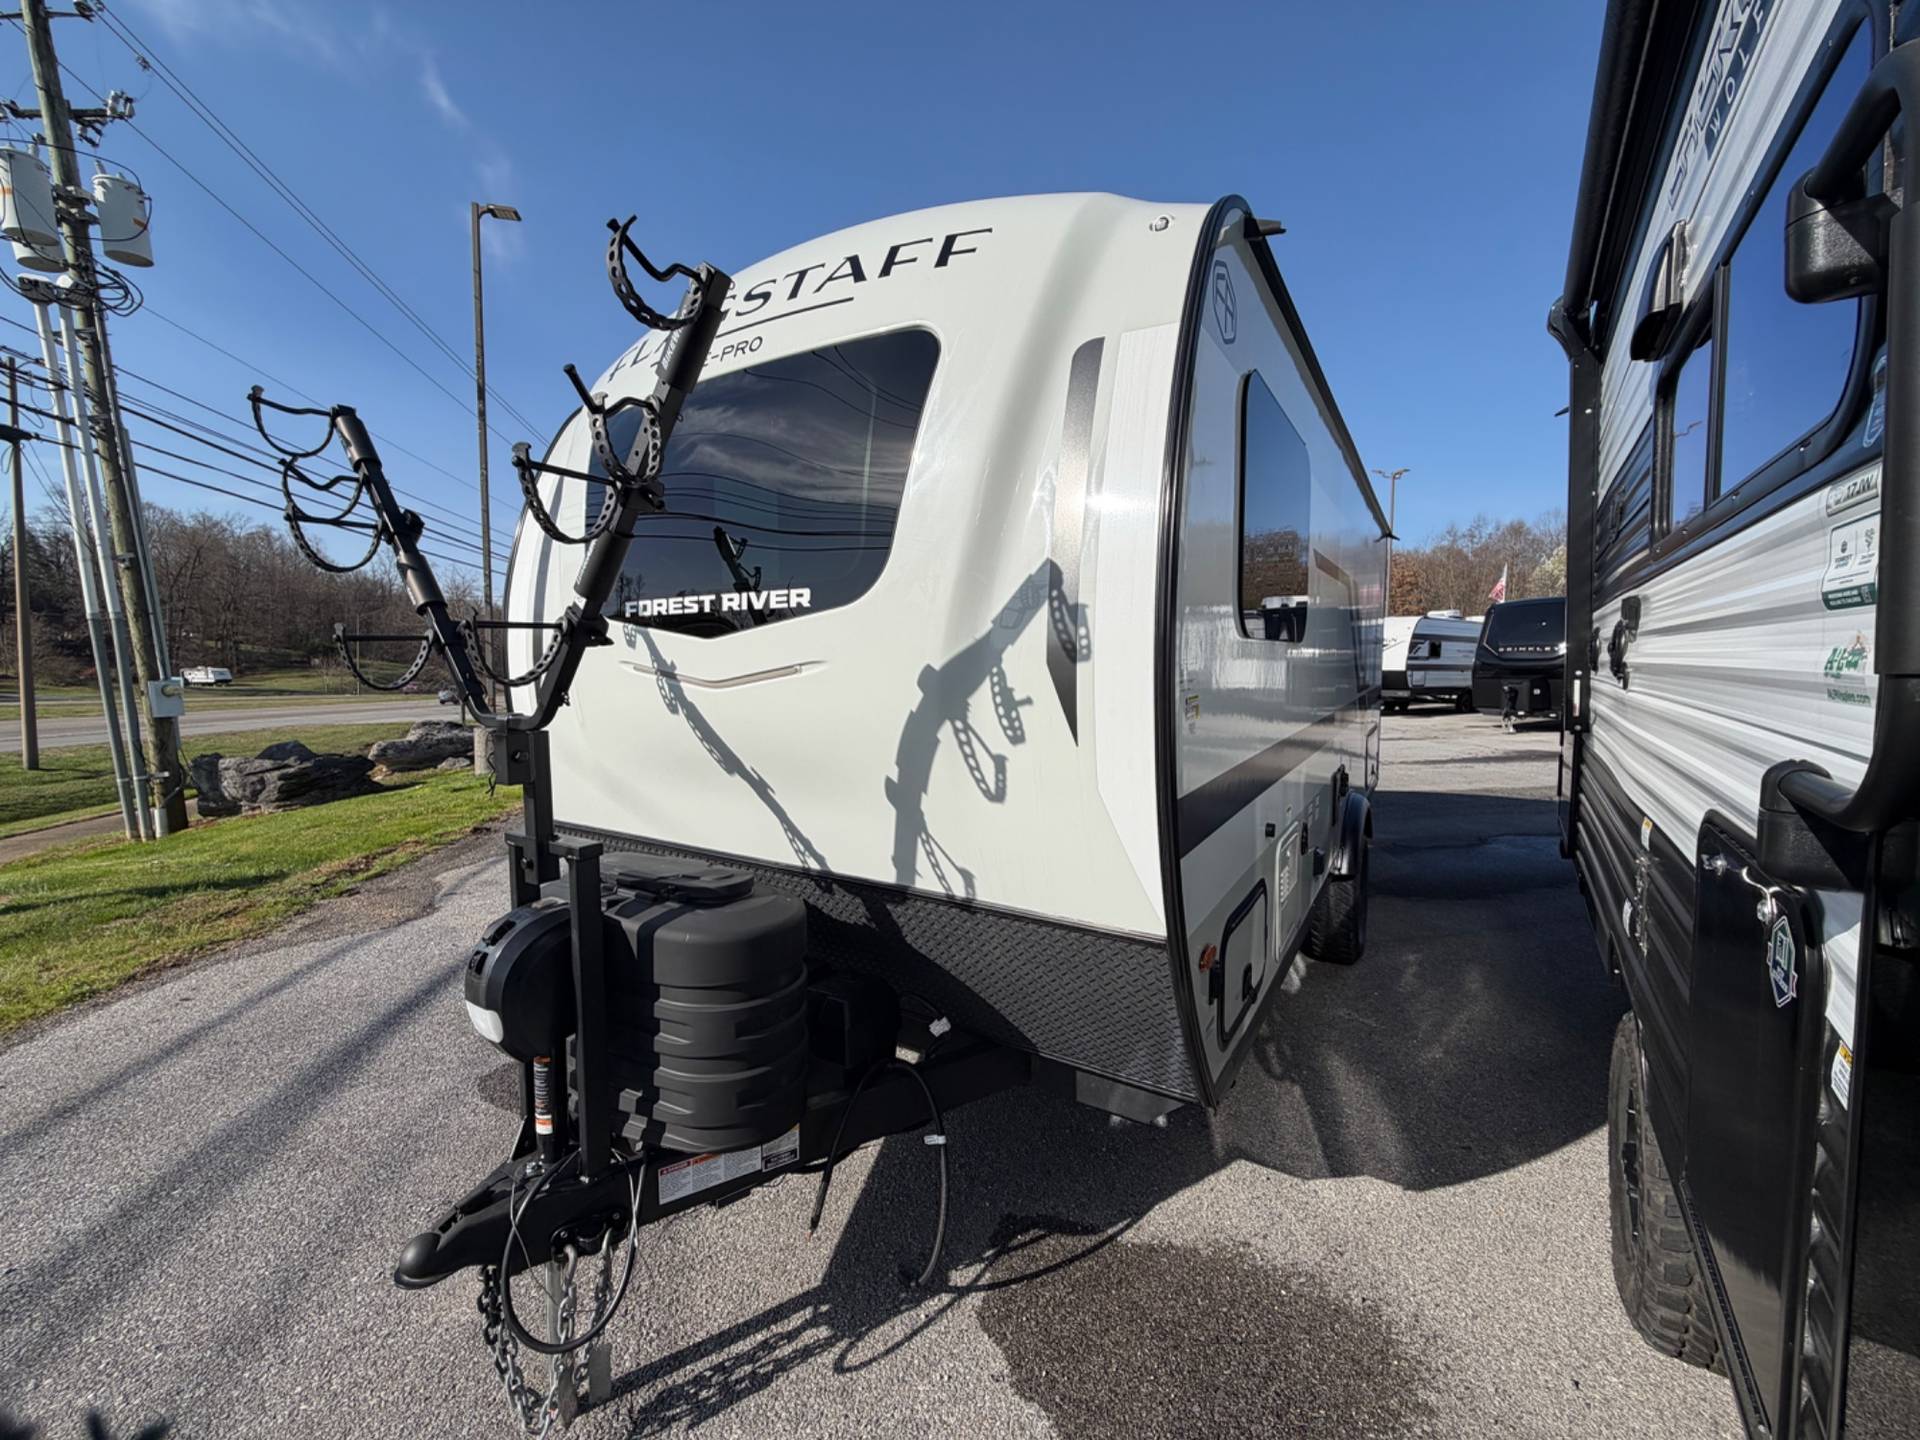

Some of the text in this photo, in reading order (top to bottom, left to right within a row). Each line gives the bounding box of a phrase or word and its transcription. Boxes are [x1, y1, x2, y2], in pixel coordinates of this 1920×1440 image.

[607, 227, 993, 384] FLSTAFF
[702, 335, 764, 369] -PRO
[624, 587, 812, 618] FOREST RIVER
